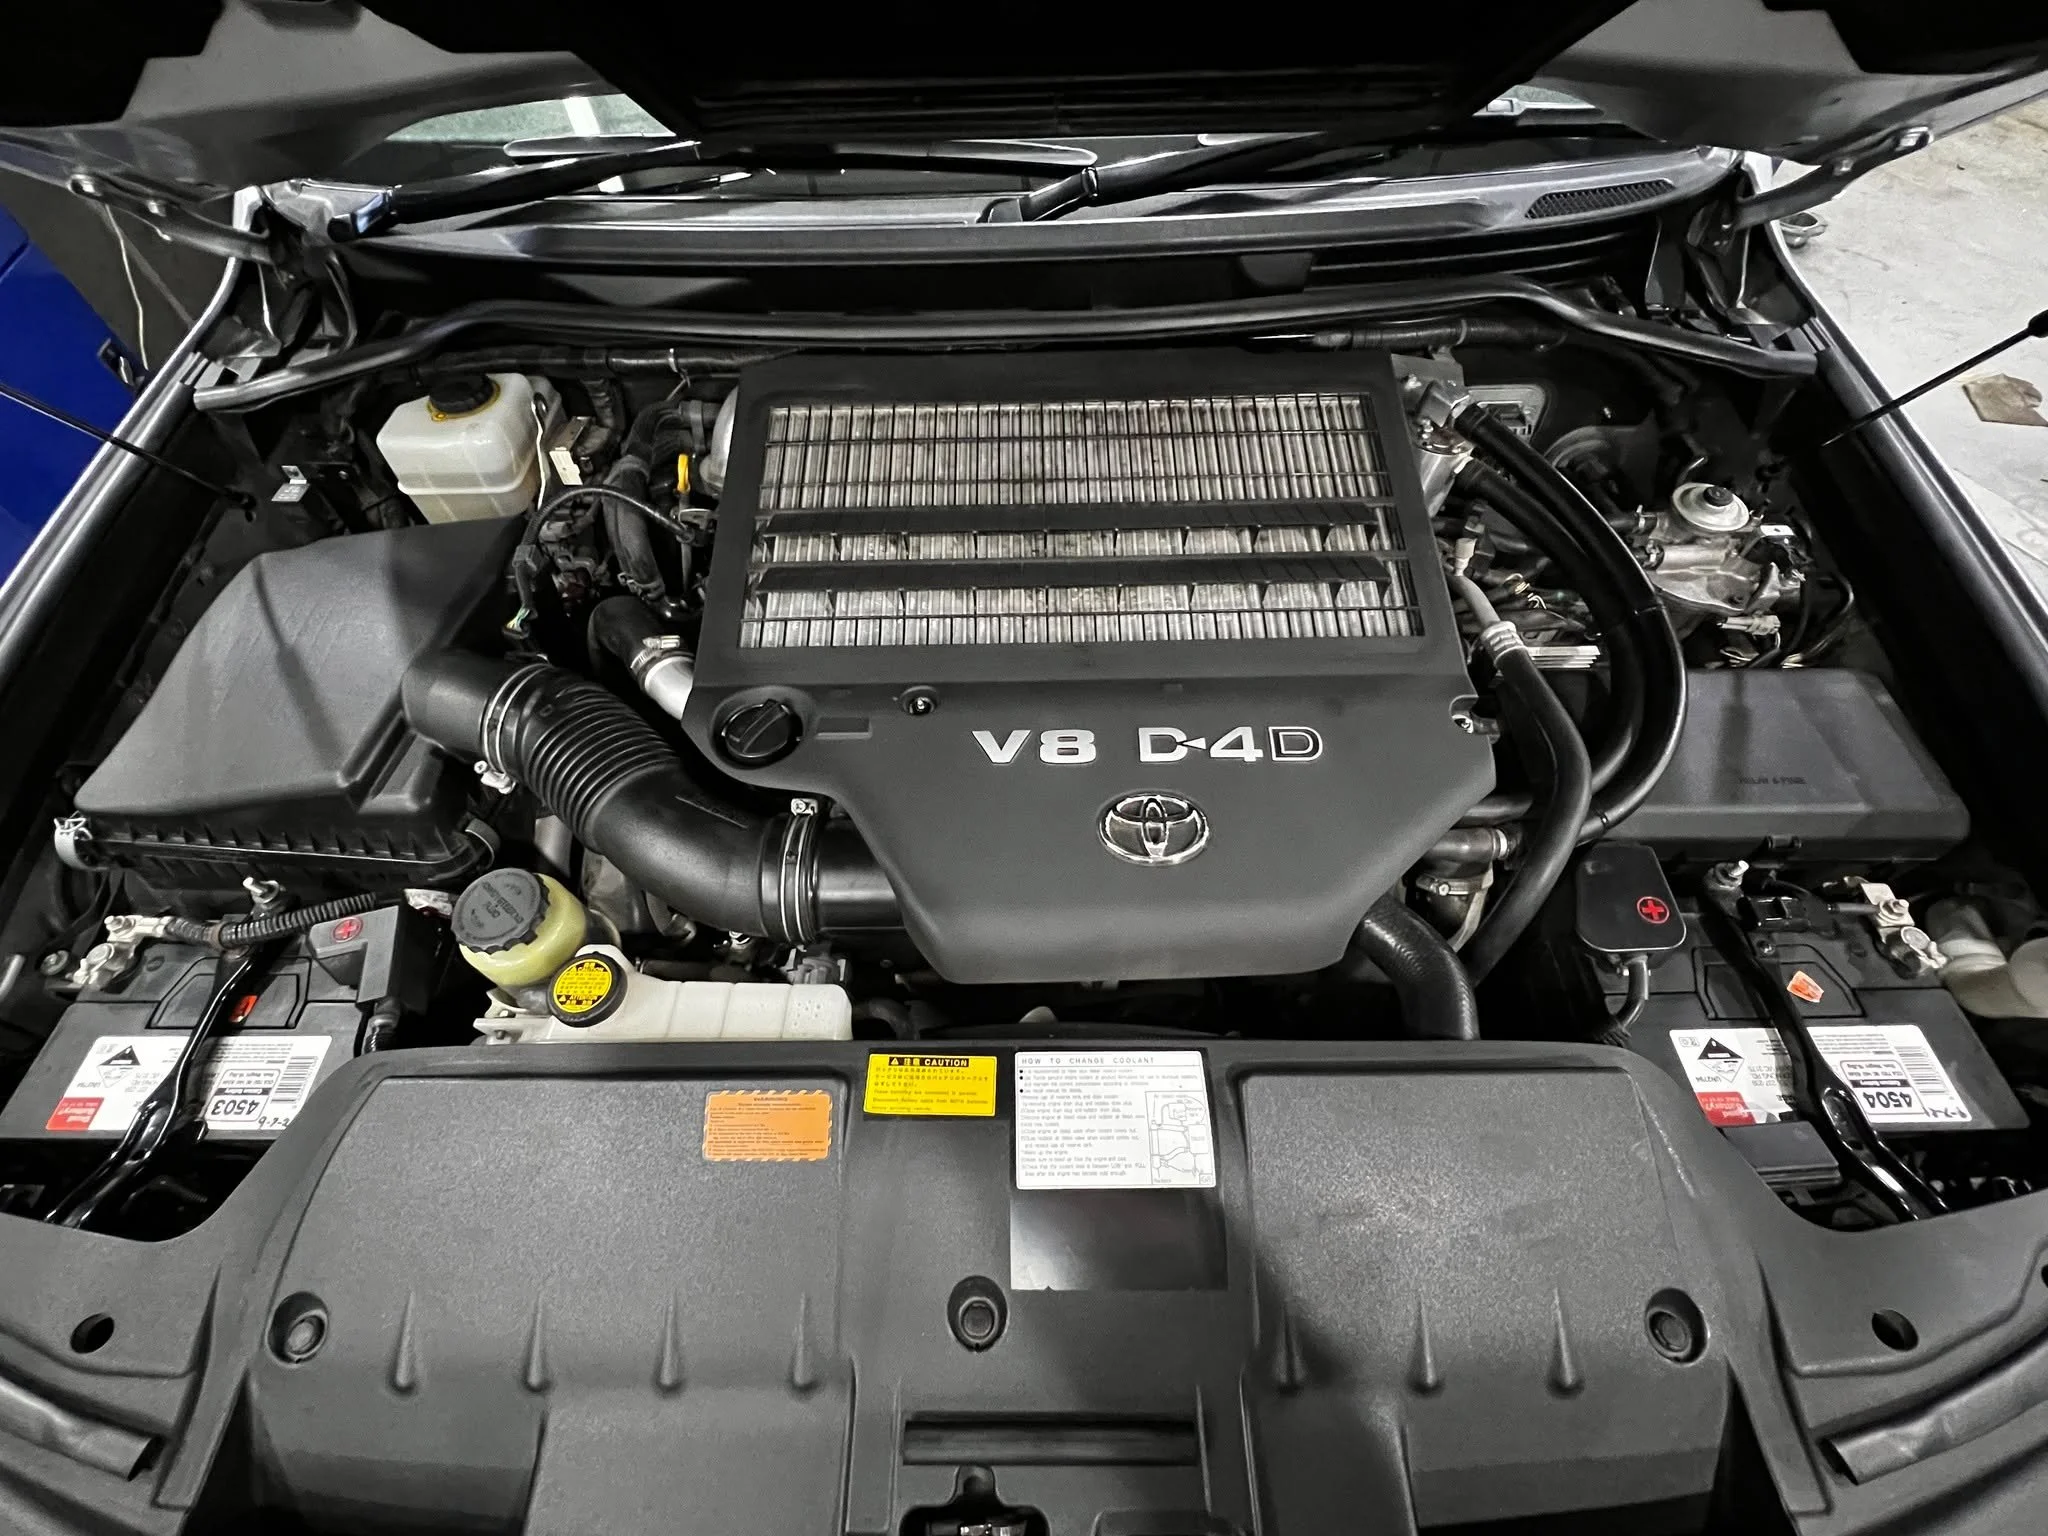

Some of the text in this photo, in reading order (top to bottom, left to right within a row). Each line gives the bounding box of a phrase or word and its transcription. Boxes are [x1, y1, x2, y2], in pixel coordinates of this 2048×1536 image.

[972, 729, 1096, 765] V8
[924, 1058, 967, 1067] CAUTION
[1113, 1056, 1154, 1064] COOLANT
[211, 1099, 260, 1115] 4503
[1862, 1091, 1912, 1108] 4504
